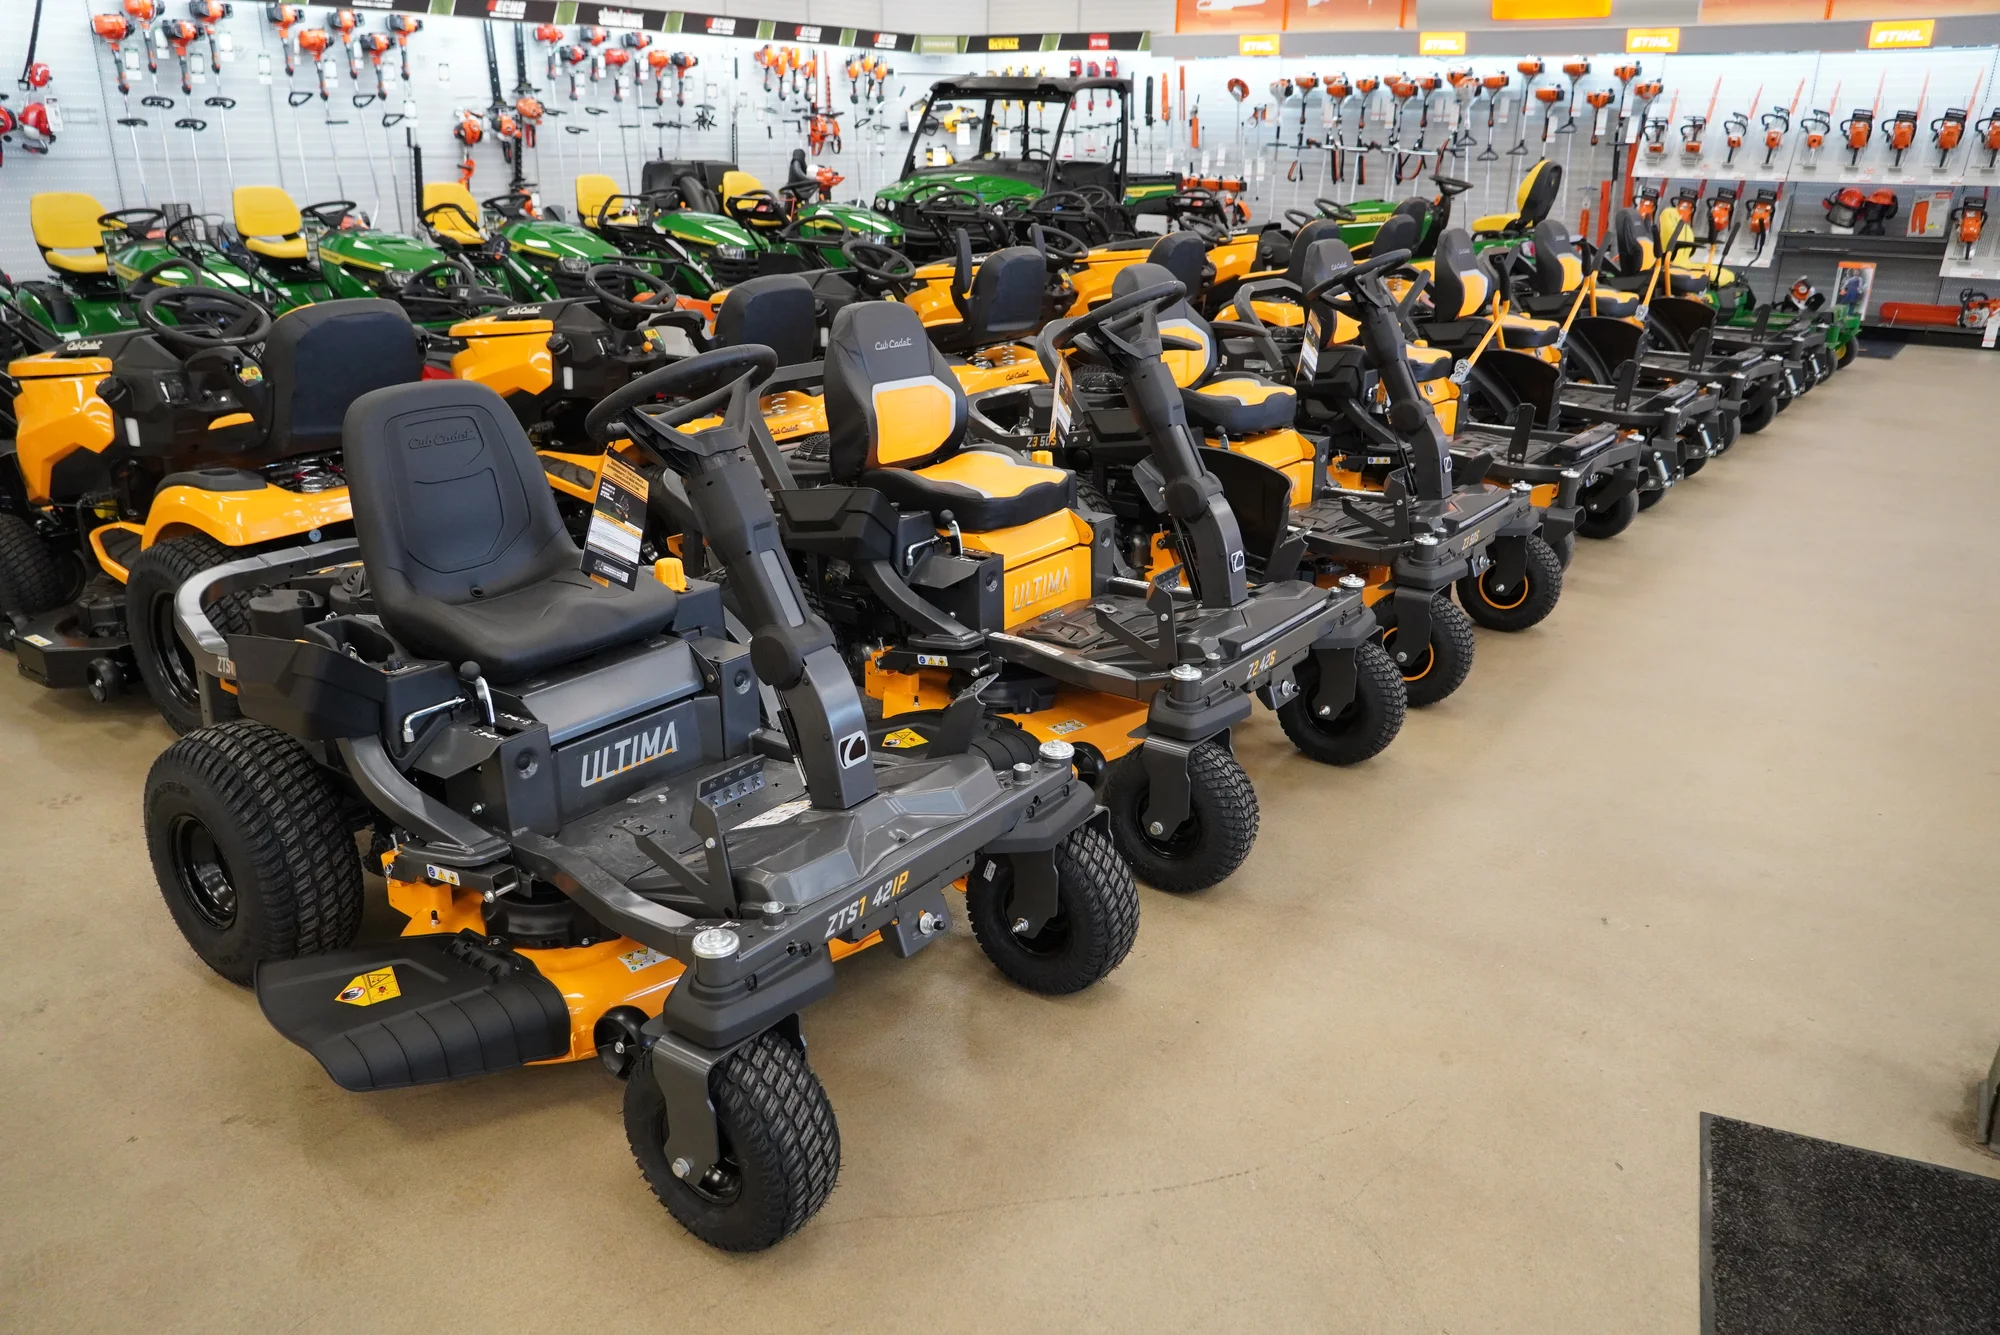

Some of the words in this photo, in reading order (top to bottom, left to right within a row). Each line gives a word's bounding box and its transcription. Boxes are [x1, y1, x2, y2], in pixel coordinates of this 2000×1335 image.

[1631, 36, 1672, 48] STIHL
[1875, 29, 1924, 43] STIHL
[875, 340, 889, 351] Cub
[889, 336, 913, 349] Cadet
[781, 424, 800, 434] Cadet
[1026, 435, 1039, 448] Z3
[1012, 565, 1070, 611] ULTIMA
[1246, 659, 1260, 680] Z2
[1260, 649, 1277, 672] 42S
[580, 720, 679, 788] ULTIMA
[824, 895, 867, 939] ZTS1
[871, 869, 910, 907] 42IP
